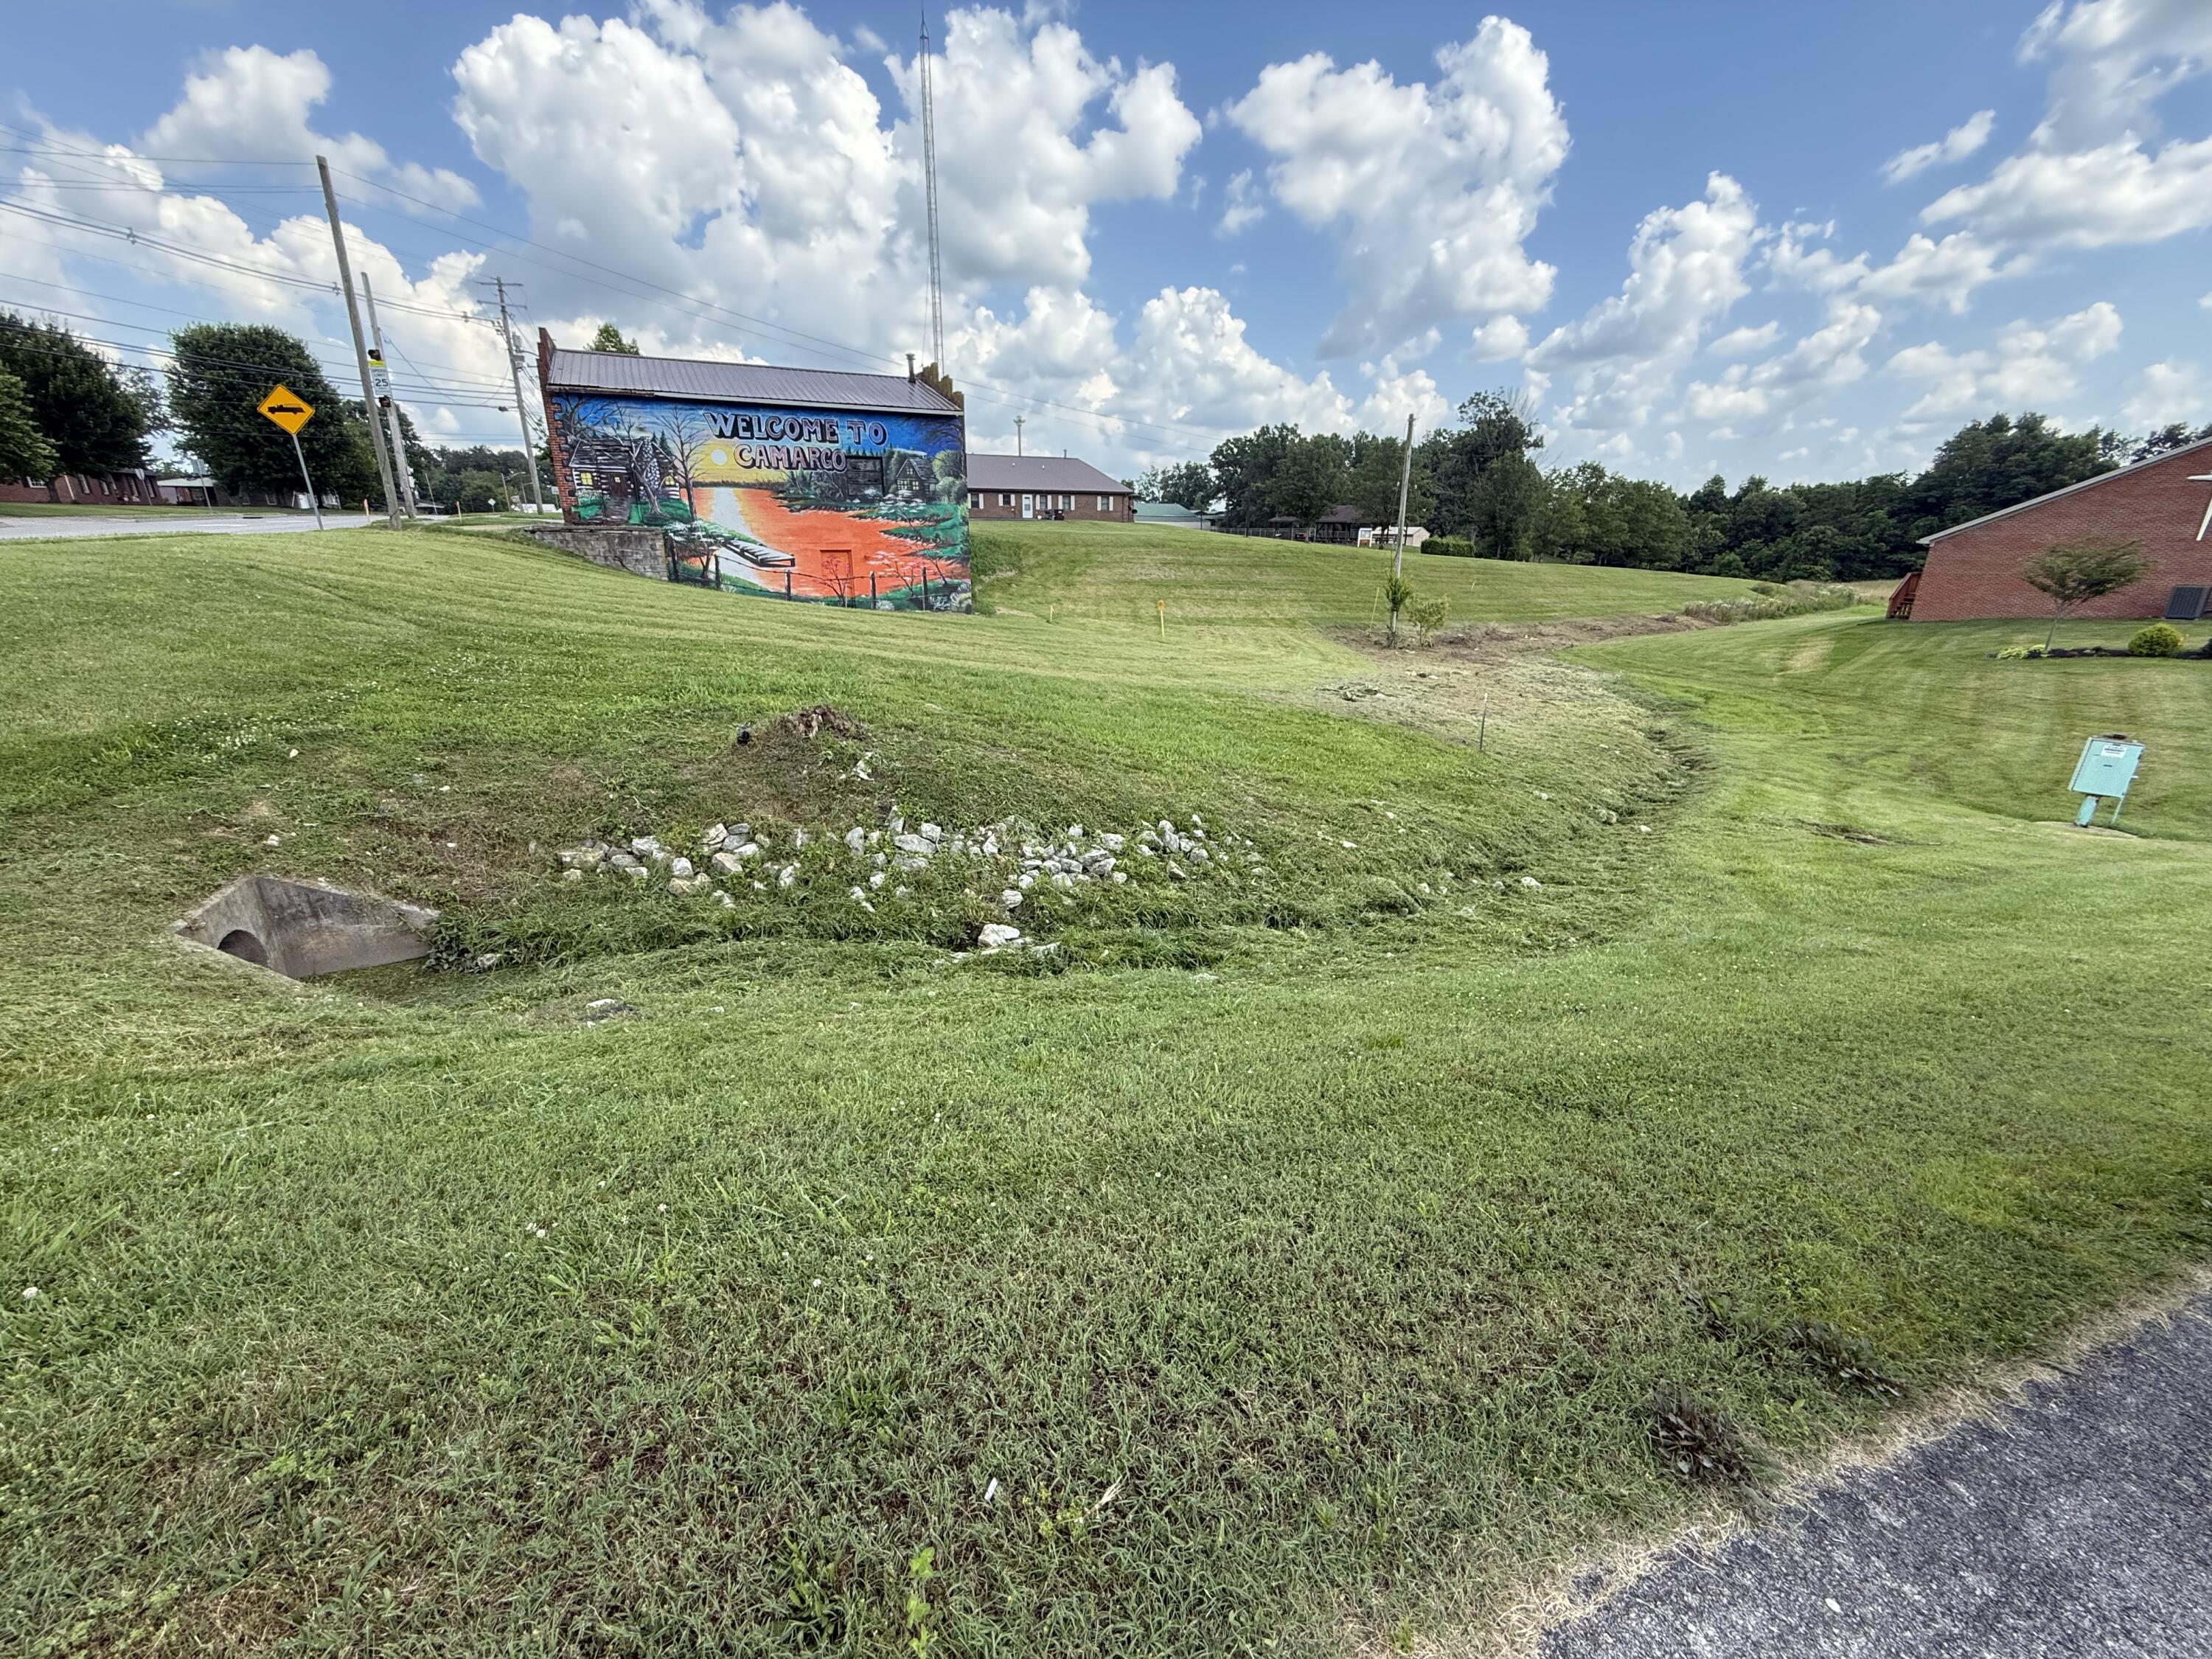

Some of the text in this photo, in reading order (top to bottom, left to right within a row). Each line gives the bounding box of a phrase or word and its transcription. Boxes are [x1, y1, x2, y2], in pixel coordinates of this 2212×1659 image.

[375, 378, 389, 387] 25
[703, 412, 887, 445] WELCOME TO
[733, 444, 846, 473] CAMARGO
